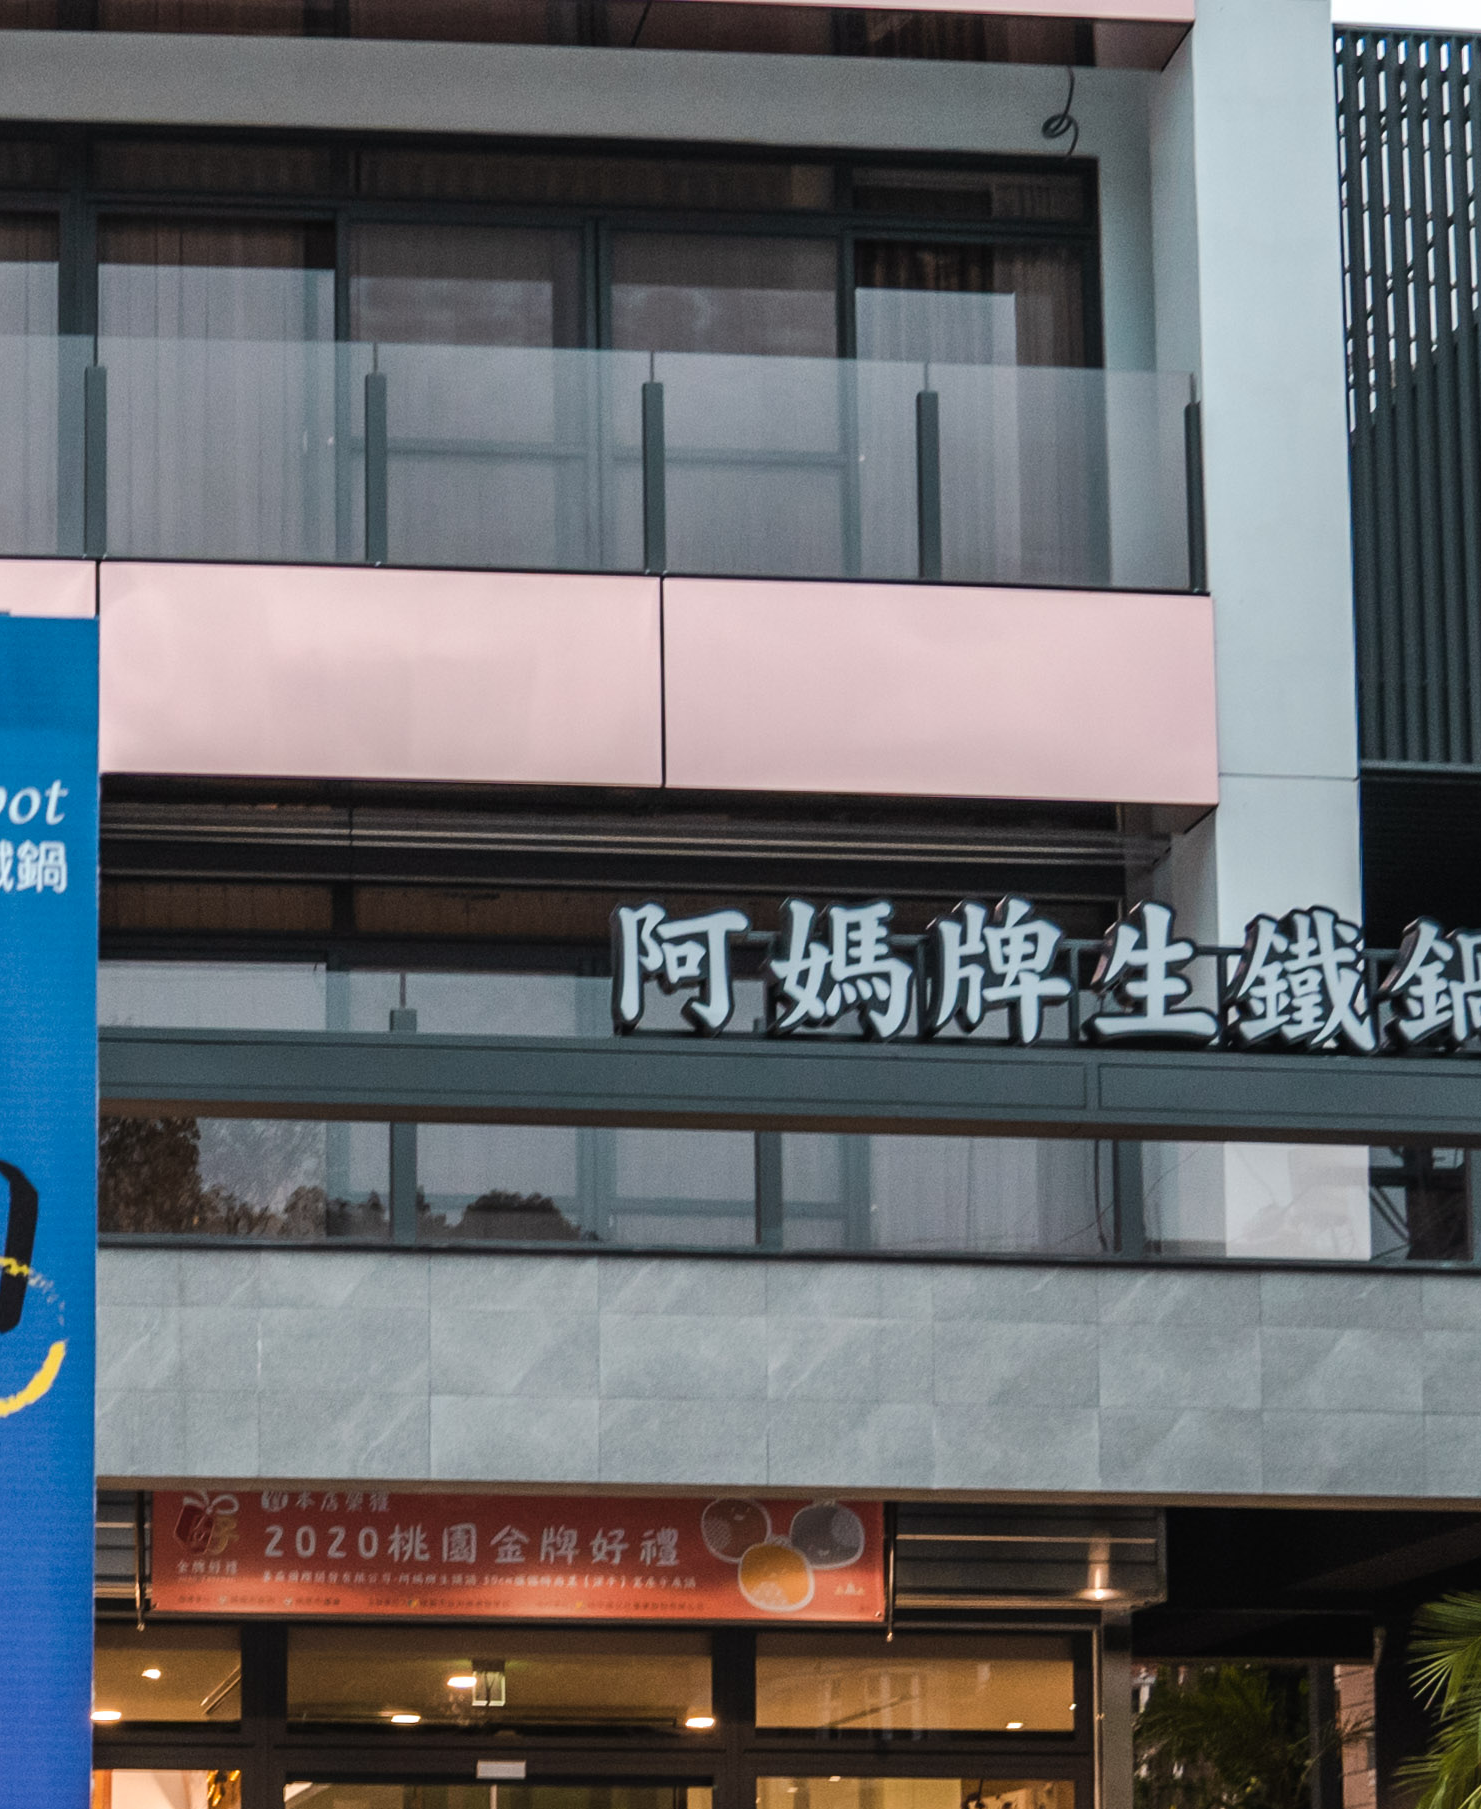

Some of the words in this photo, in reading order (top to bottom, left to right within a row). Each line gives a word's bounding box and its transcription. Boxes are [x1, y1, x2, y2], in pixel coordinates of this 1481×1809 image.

[263, 1524, 680, 1567] 2020桃園金牌好禮
